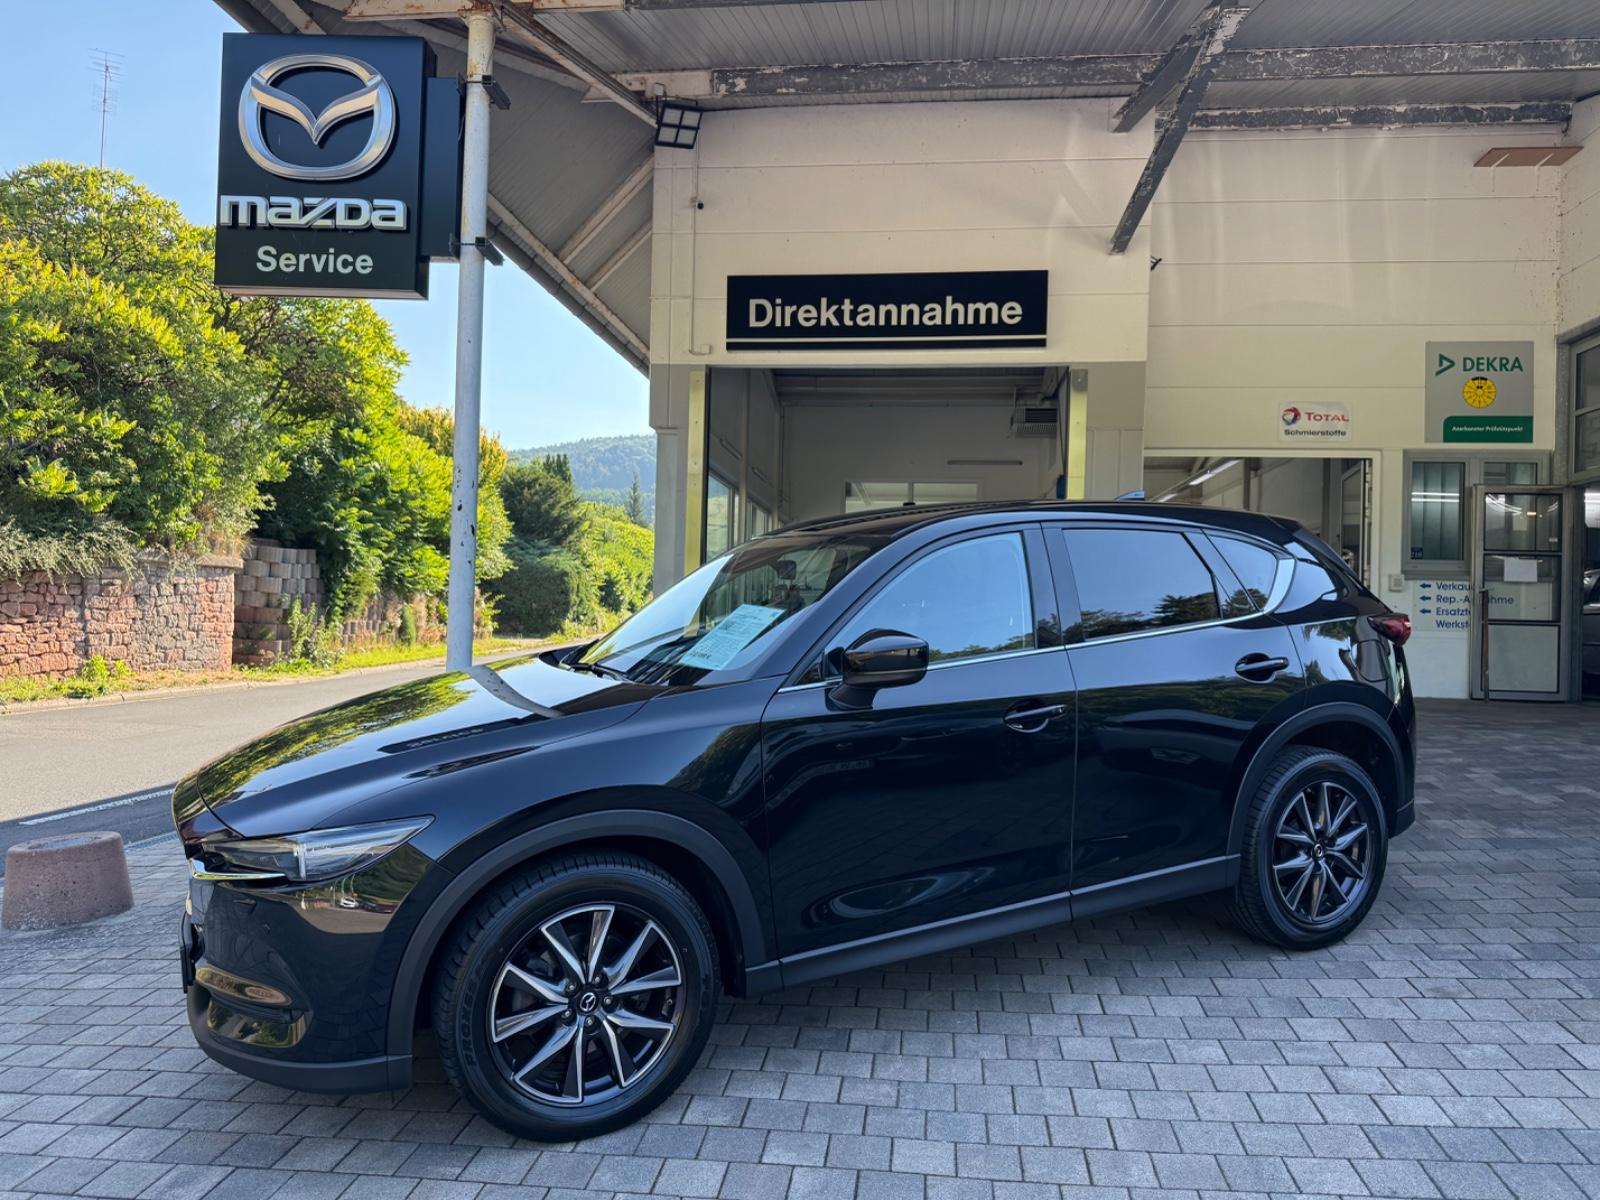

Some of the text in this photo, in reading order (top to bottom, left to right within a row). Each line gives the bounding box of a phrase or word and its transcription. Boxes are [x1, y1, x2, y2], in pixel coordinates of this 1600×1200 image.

[256, 245, 374, 274] Service
[749, 296, 1023, 328] Direktannahme
[1462, 356, 1524, 372] DEKRA
[1304, 411, 1350, 423] TOTAL
[1284, 429, 1347, 437] Schmierstoffe
[1435, 582, 1473, 591] Verkau
[1435, 620, 1470, 629] Werkst
